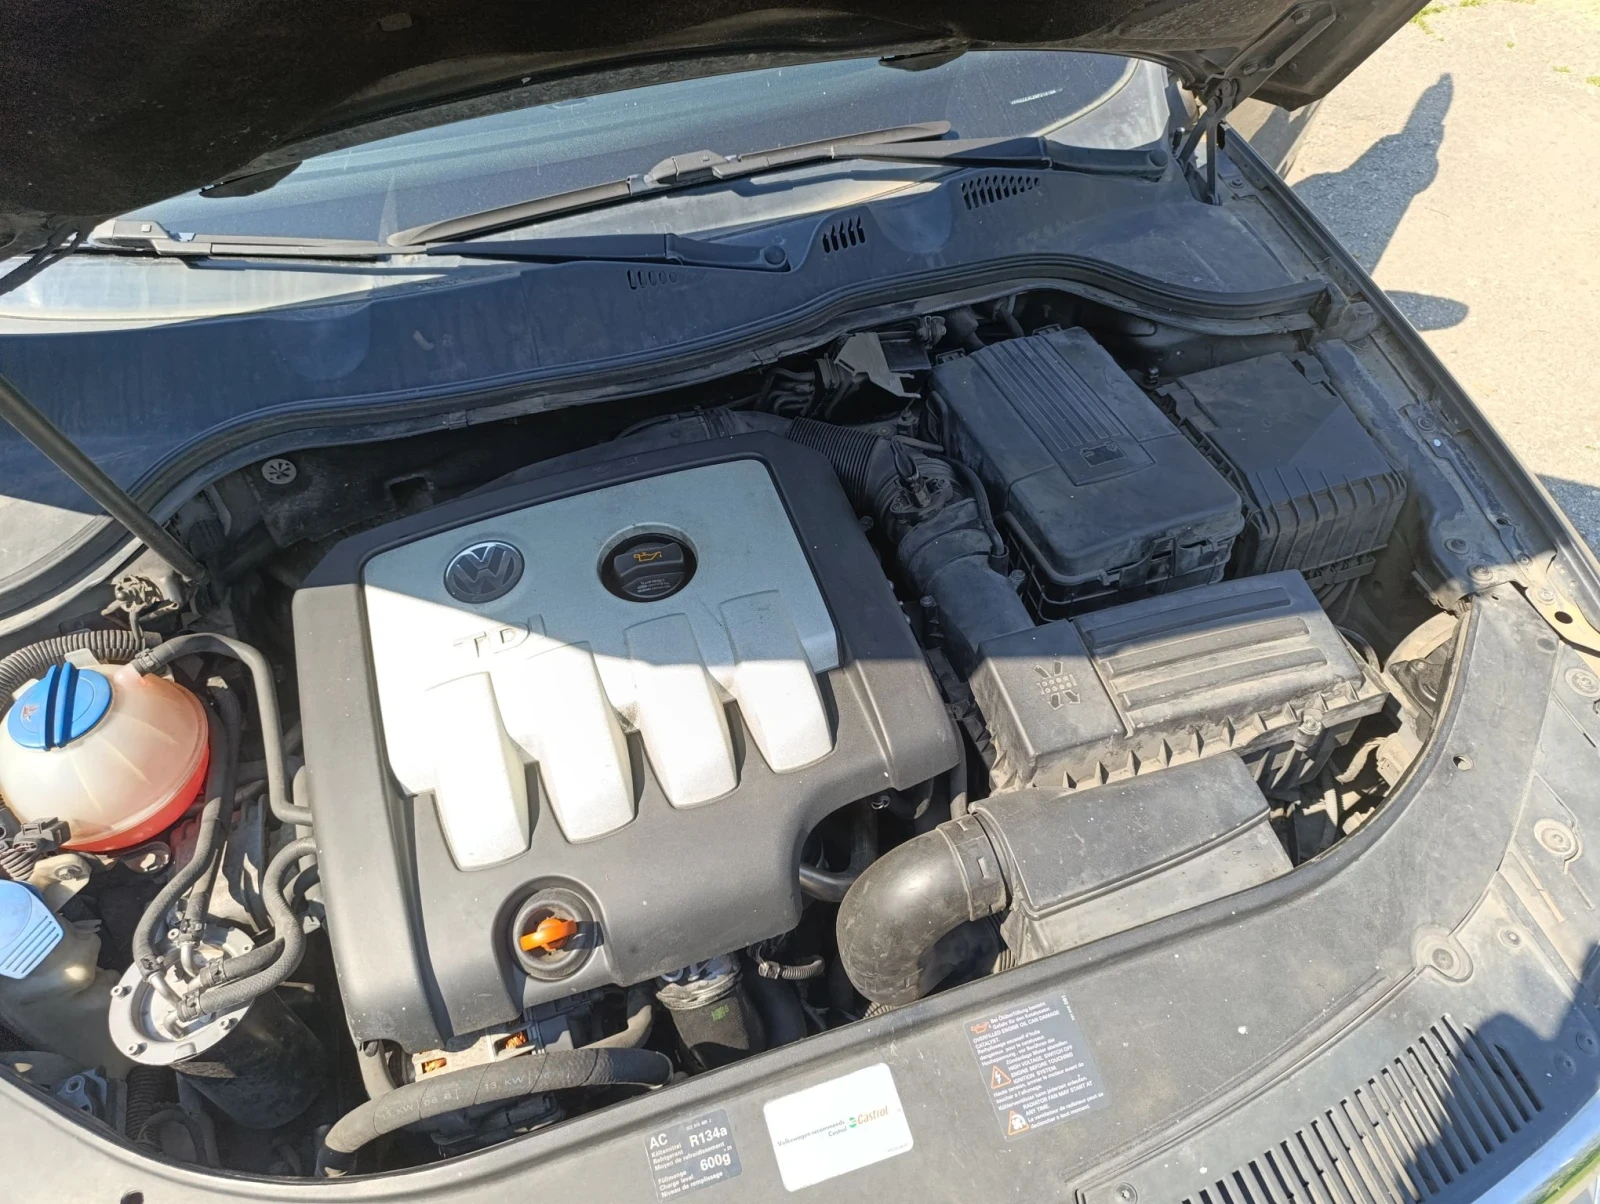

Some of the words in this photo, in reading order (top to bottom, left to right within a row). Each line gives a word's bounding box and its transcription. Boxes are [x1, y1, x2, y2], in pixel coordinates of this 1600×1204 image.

[1039, 1010, 1060, 1021] DAMAGE
[1029, 1061, 1048, 1072] BEFORE
[1048, 1052, 1074, 1065] TOUCHING
[1023, 1097, 1048, 1110] RADIATOR
[1070, 1083, 1086, 1093] START
[856, 1106, 889, 1125] Castrol
[650, 1133, 668, 1150] AC
[689, 1127, 728, 1148] R134a
[777, 1132, 812, 1147] Volkswagen
[812, 1120, 846, 1135] recommends
[828, 1126, 848, 1137] Castrol
[700, 1153, 731, 1171] 600g
[660, 1181, 680, 1191] Charge
[680, 1174, 694, 1183] level
